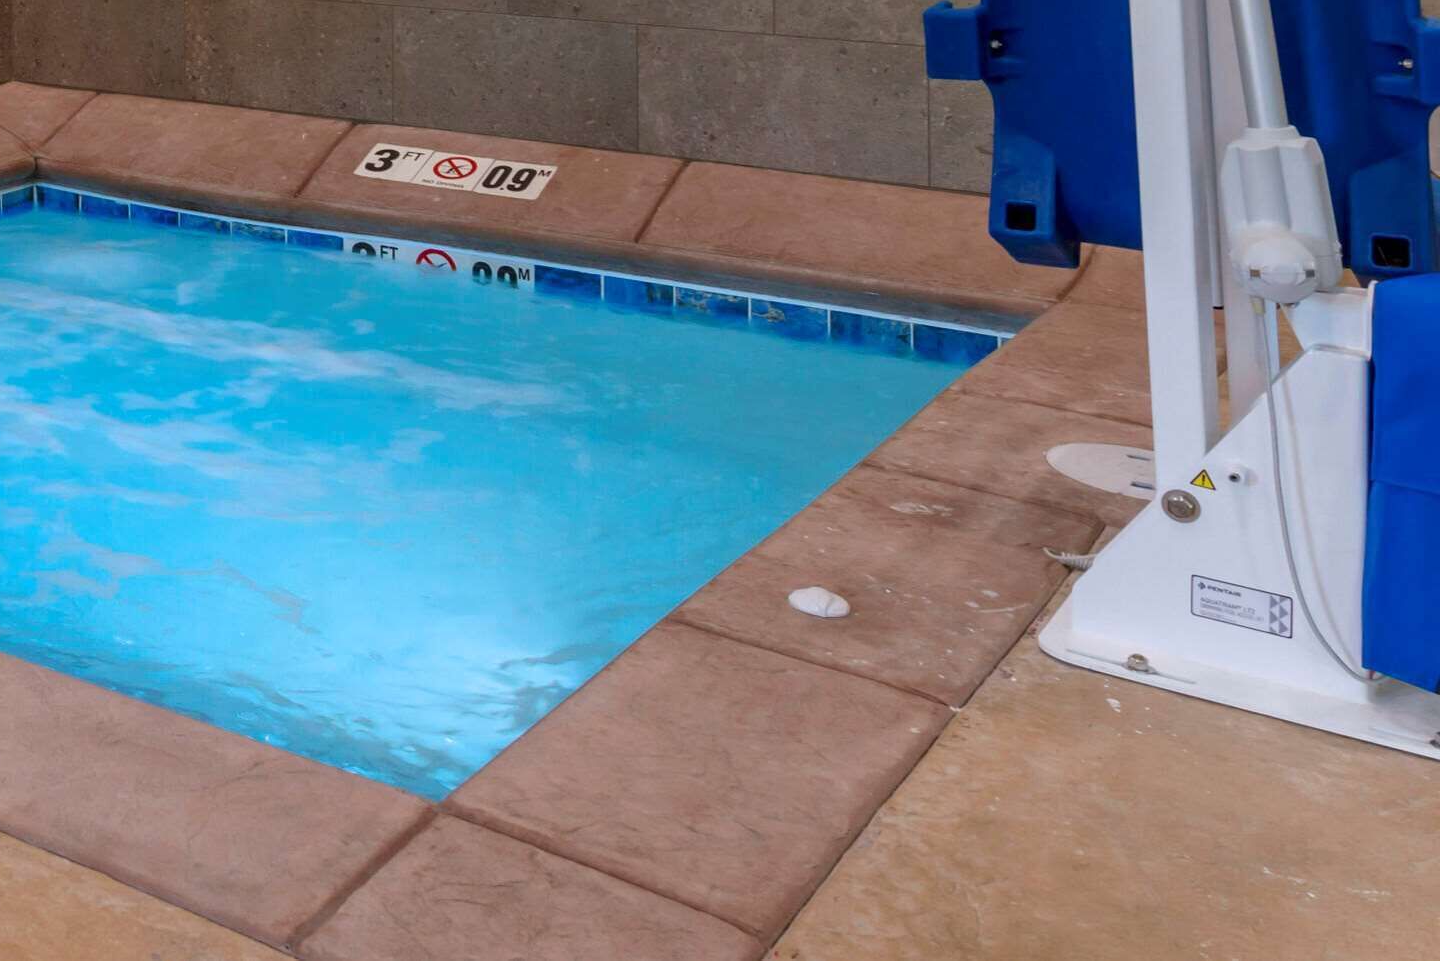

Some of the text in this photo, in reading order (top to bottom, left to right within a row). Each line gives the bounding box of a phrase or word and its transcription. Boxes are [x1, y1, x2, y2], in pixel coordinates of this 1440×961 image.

[364, 149, 552, 192] 3 FT 0.9 M
[518, 267, 531, 281] M
